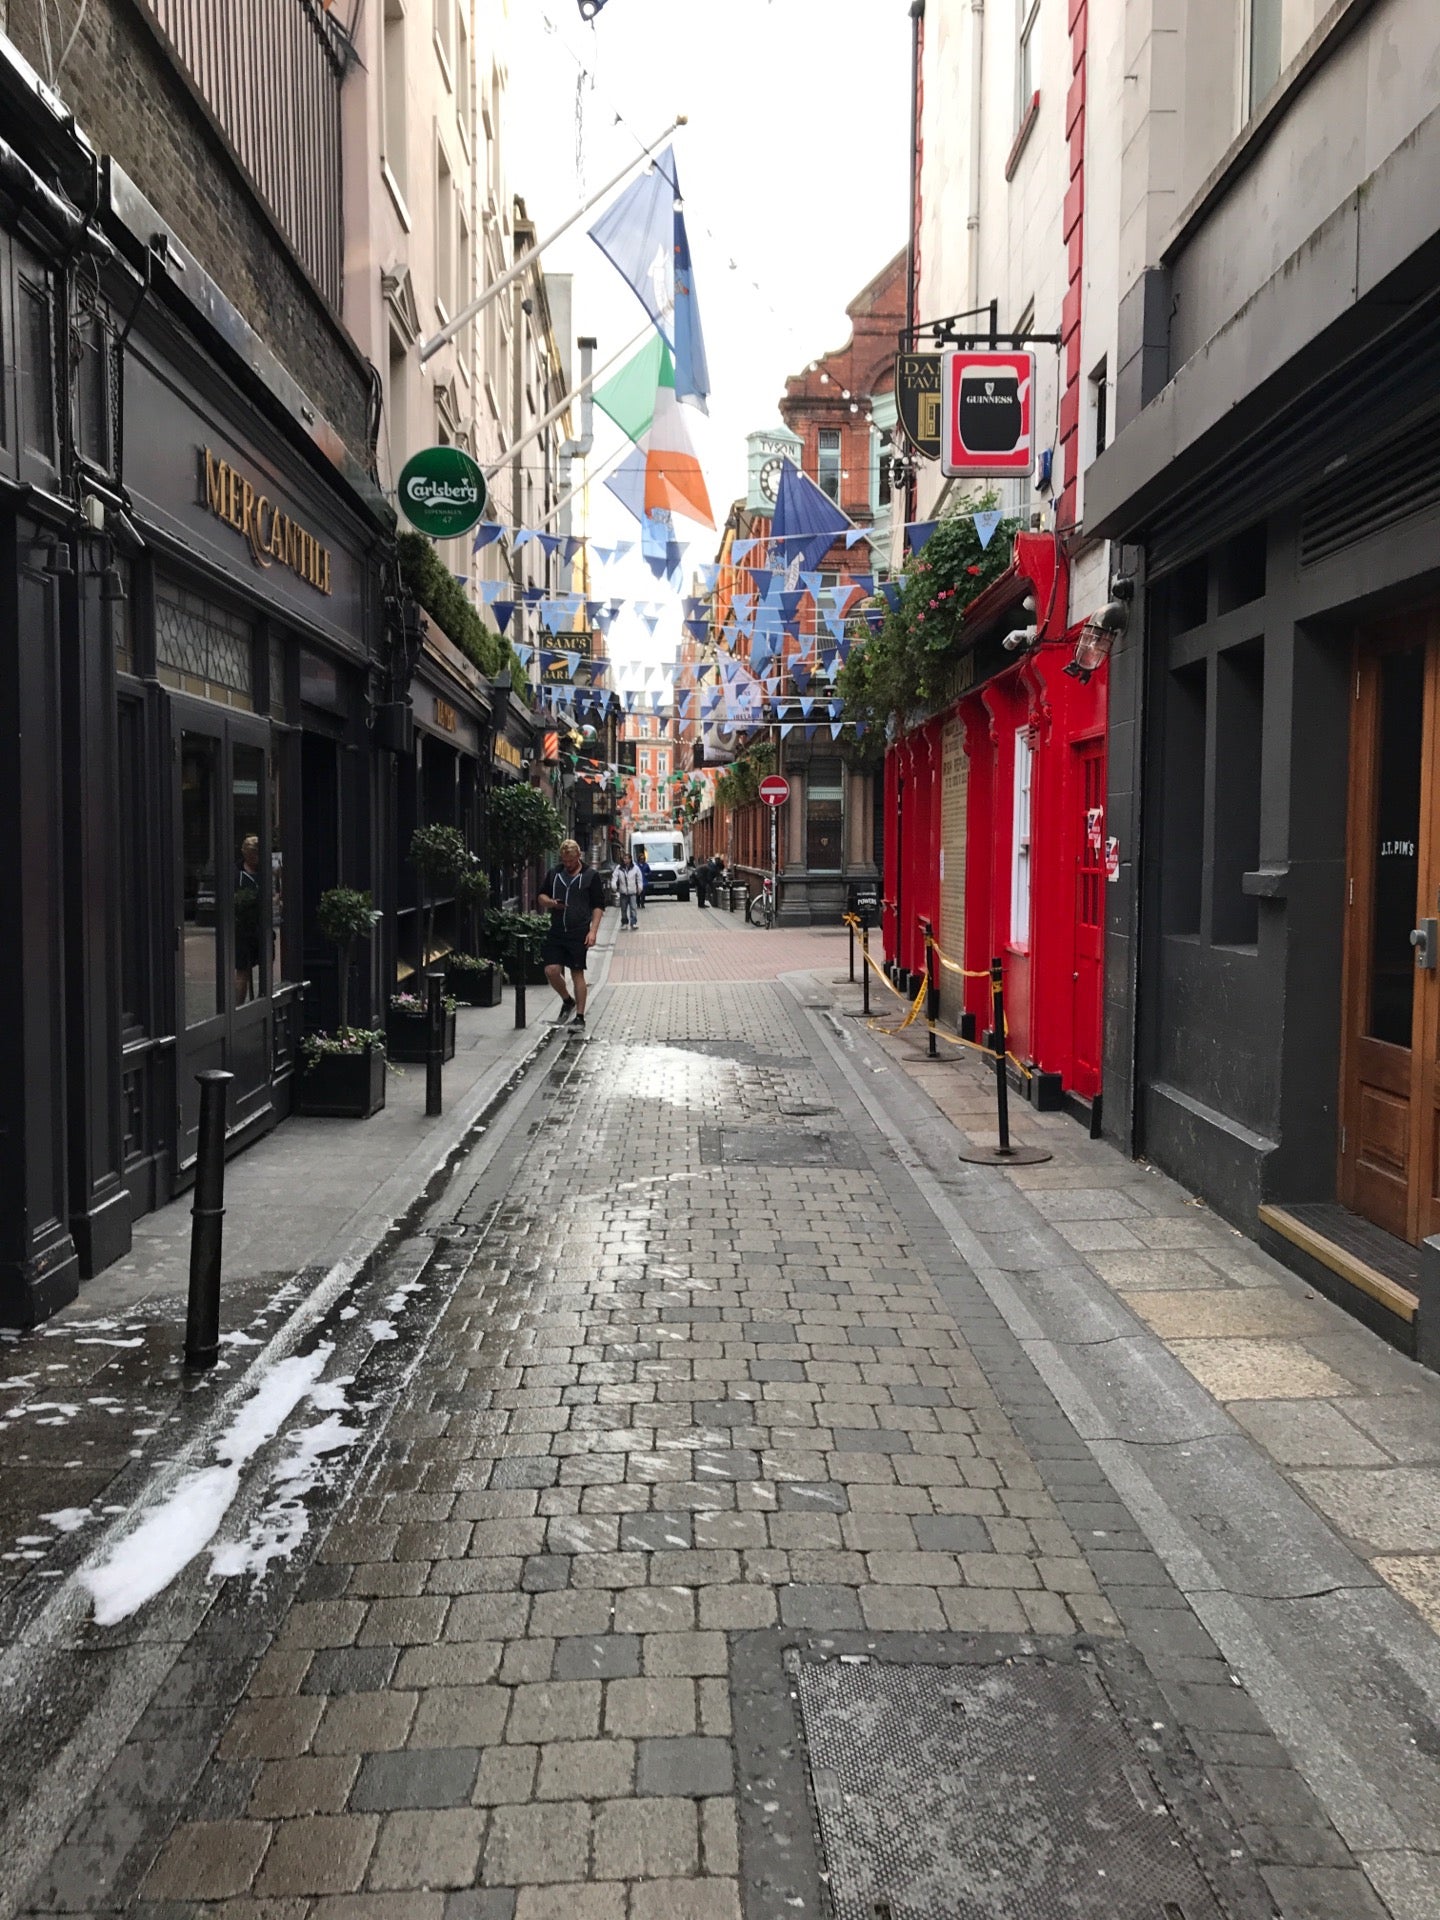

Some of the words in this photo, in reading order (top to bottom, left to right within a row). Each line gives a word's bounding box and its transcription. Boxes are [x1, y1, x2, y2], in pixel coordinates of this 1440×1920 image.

[966, 395, 1013, 404] GUINNESS
[760, 439, 795, 456] TYSON
[407, 477, 478, 504] Carlsberg
[206, 448, 332, 596] MERCANTILE
[545, 637, 587, 649] SAM'S
